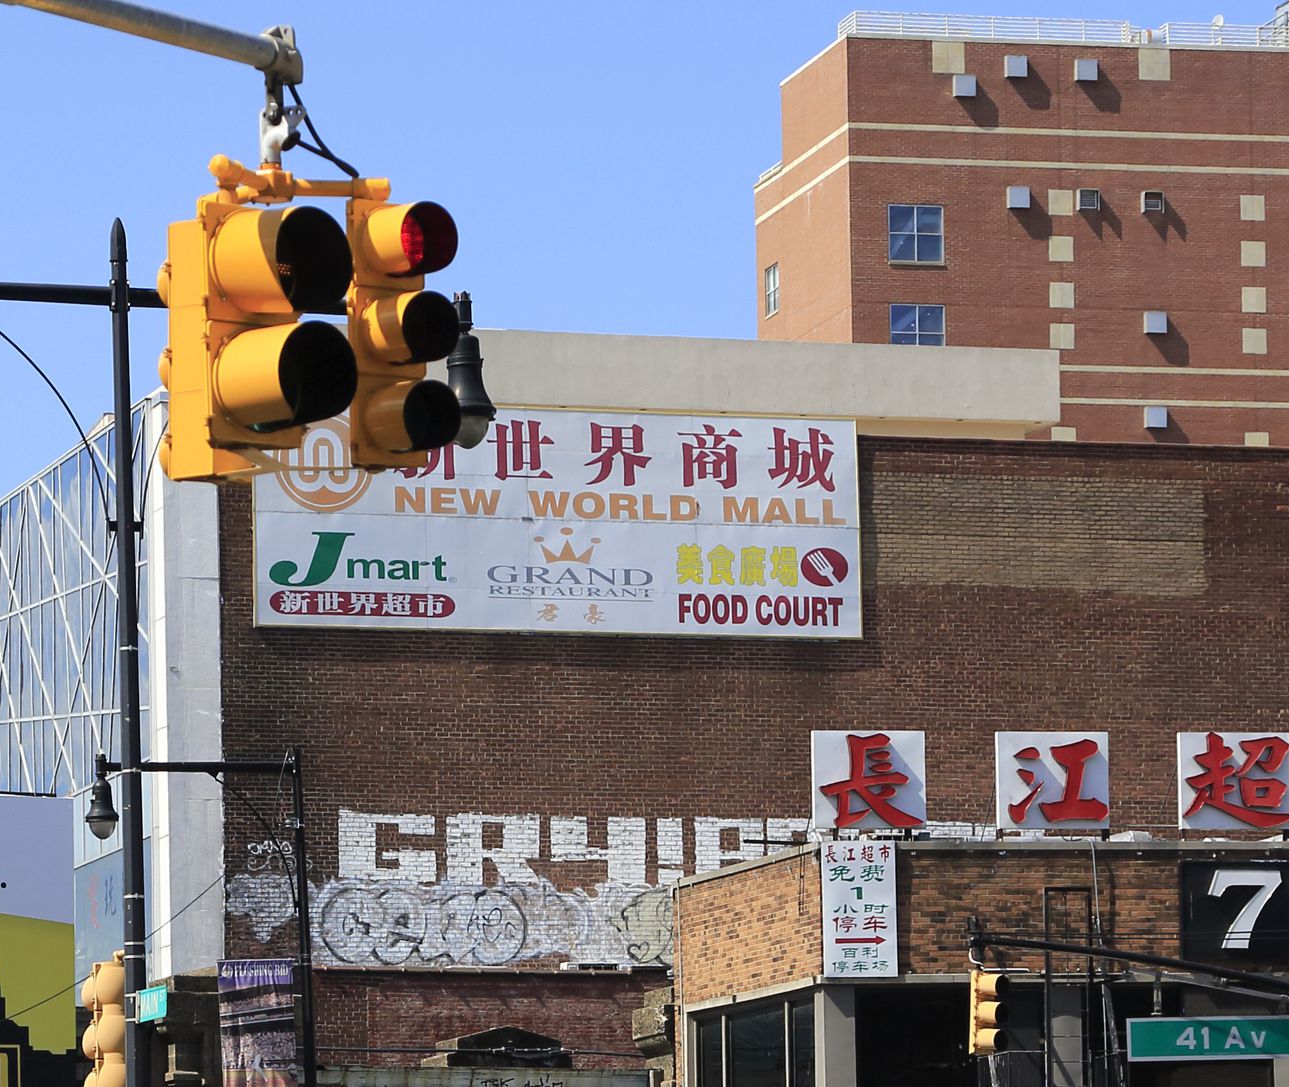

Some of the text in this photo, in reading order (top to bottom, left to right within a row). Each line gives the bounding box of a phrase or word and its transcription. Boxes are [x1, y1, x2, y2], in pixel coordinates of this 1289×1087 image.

[394, 486, 847, 526] NEW WORLD MALL
[676, 544, 799, 587] 美食廣場
[487, 564, 654, 588] GRAND
[489, 585, 655, 599] RESTAURANT
[279, 591, 447, 618] 新世界超市
[678, 594, 844, 627] FOOD COURT
[825, 844, 891, 864] 長江超市
[829, 864, 885, 882] 免费
[850, 886, 863, 900] 1
[833, 904, 890, 914] 小时
[832, 915, 888, 933] 停车
[841, 947, 879, 959] 百利
[234, 963, 290, 977] FLUSHING BID
[832, 960, 889, 973] 停车场
[1176, 1026, 1267, 1050] 41 Av
